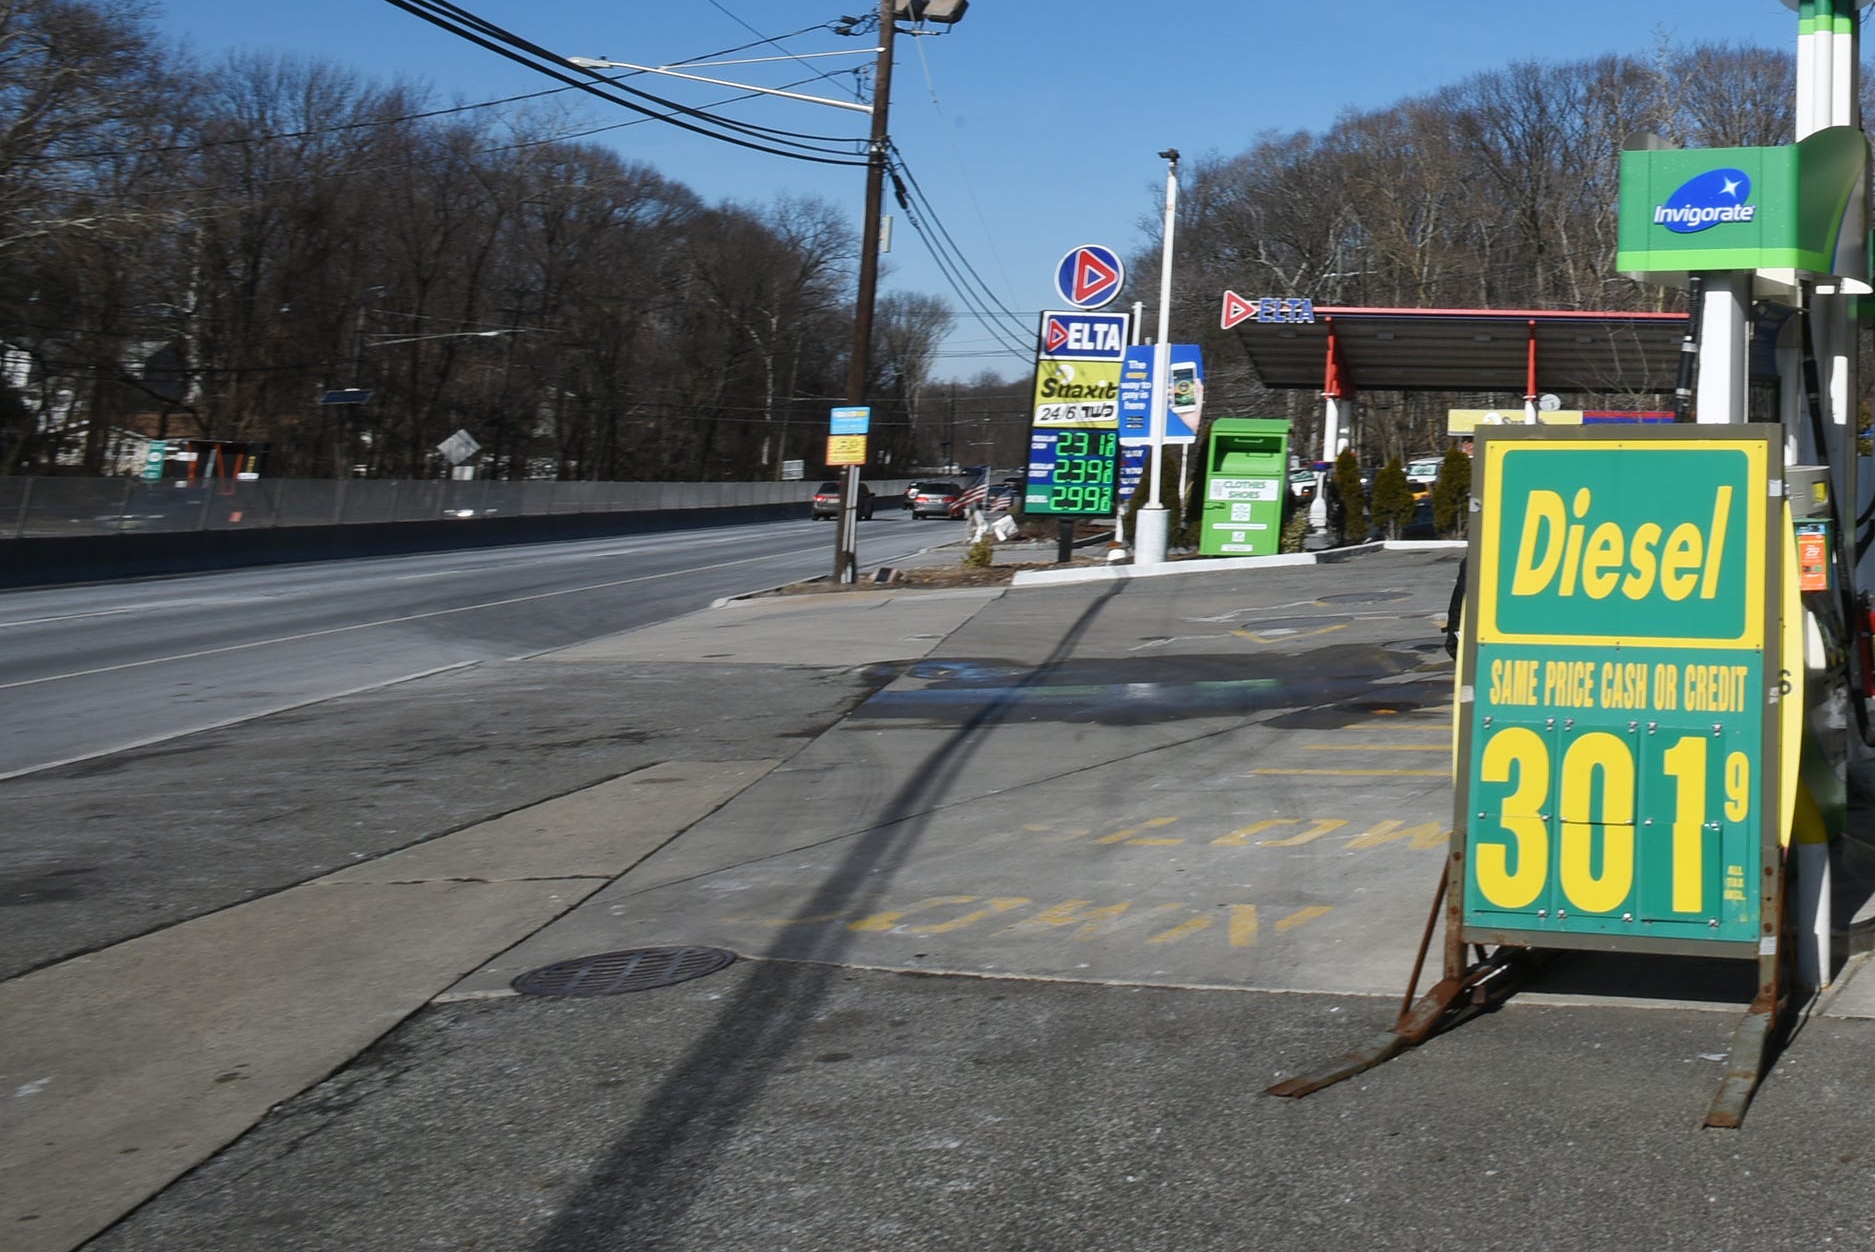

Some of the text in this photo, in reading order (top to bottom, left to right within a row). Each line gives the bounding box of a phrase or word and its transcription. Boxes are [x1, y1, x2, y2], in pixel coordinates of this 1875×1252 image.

[1653, 204, 1754, 226] Invigorate
[1041, 378, 1118, 399] Snaxit
[1511, 486, 1733, 601] Diesel
[1490, 659, 1749, 713] SAME PRICE CASH OR CREDIT
[722, 895, 1336, 948] OWN
